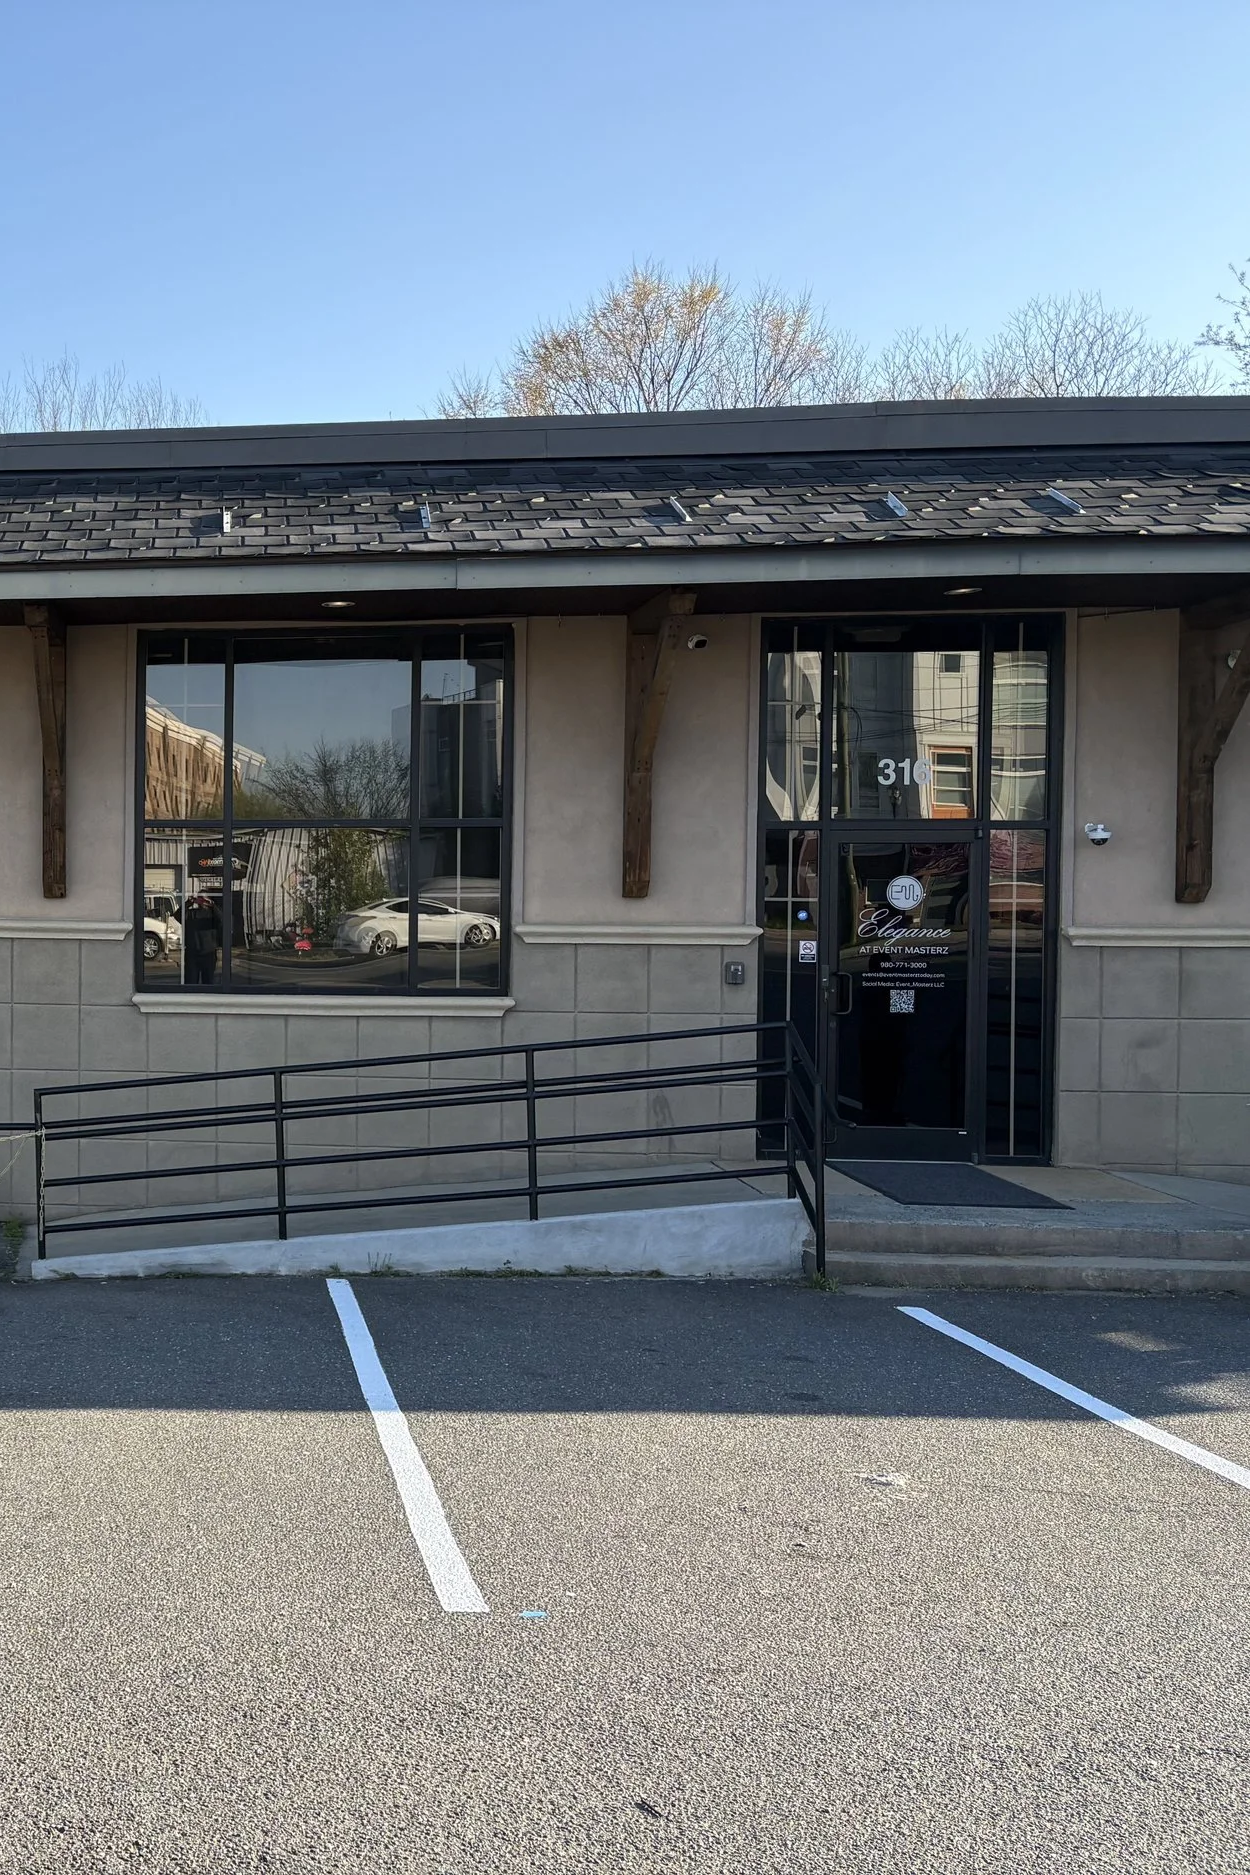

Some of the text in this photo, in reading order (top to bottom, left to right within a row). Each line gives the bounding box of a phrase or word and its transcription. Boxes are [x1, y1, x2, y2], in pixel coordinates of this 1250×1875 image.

[877, 758, 931, 785] 316
[857, 908, 951, 946] Elegance
[859, 946, 949, 955] AT EVENT MASTERZ
